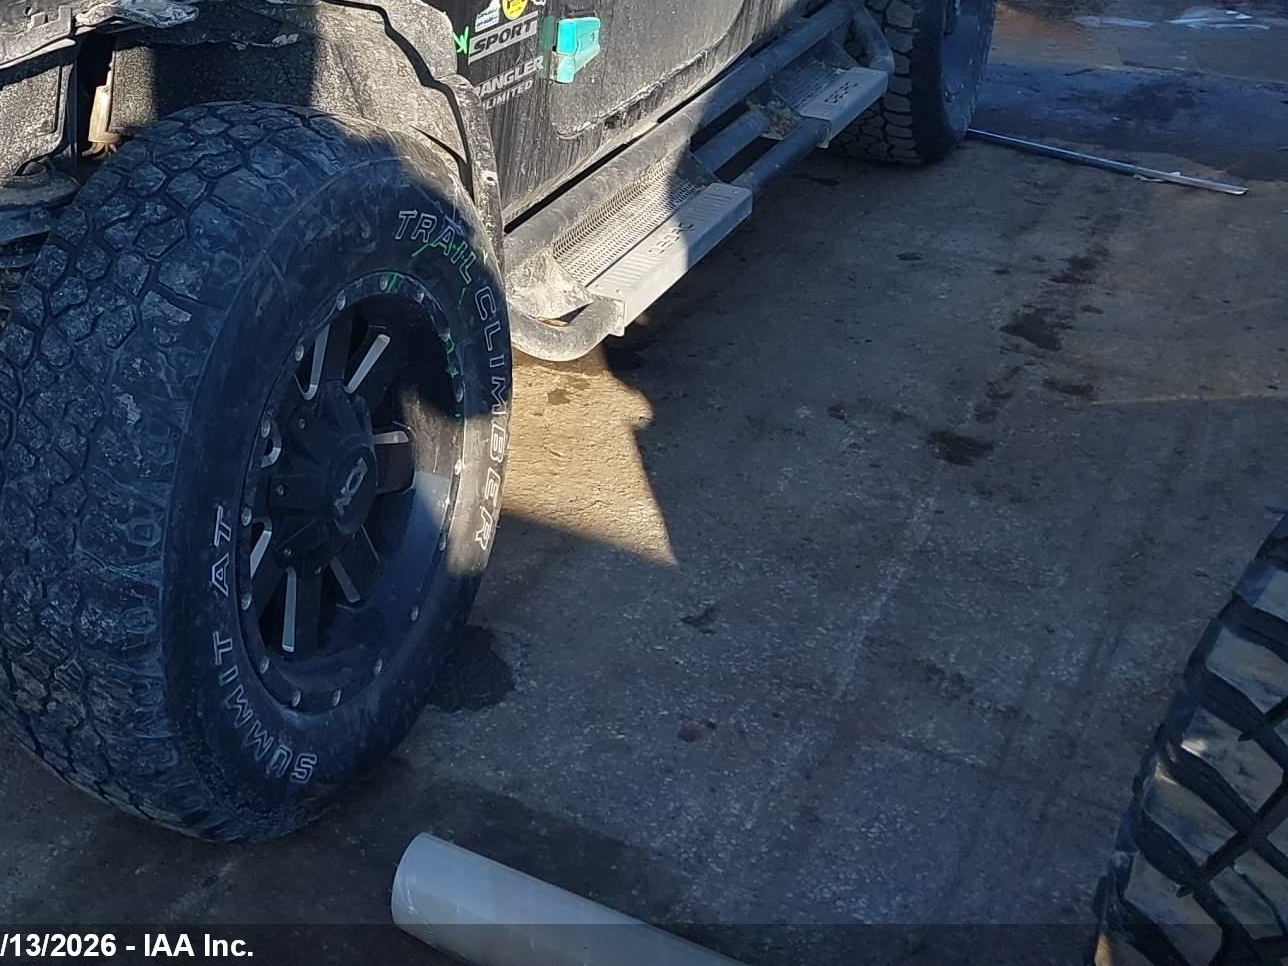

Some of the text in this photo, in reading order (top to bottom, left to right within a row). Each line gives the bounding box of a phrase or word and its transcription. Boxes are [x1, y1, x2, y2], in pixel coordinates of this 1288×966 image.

[472, 19, 534, 56] SPORT
[473, 55, 544, 98] RANGLER
[394, 209, 509, 552] TRAIL CLIMBER
[211, 505, 318, 784] SUMMIT AT
